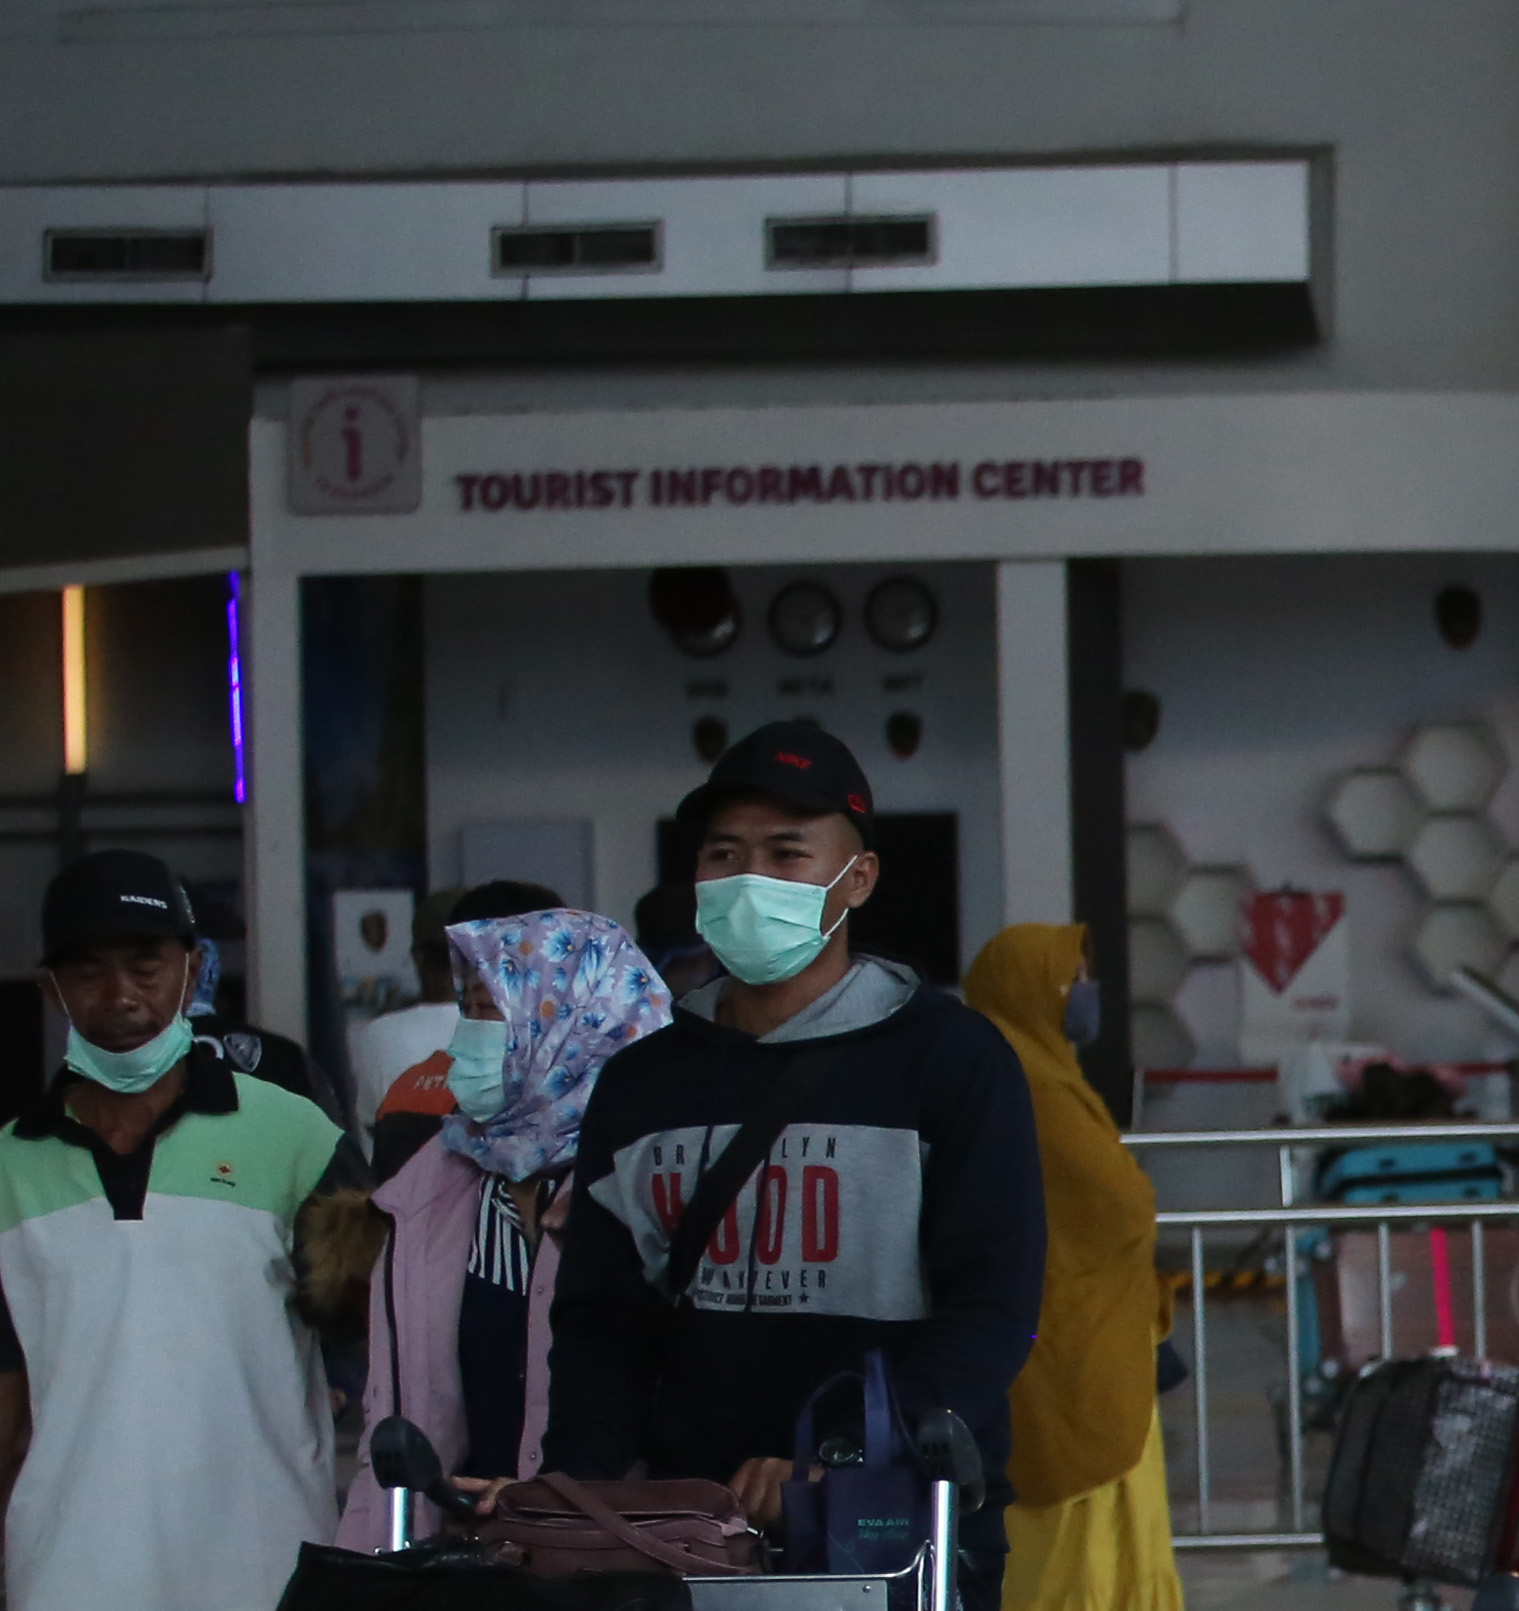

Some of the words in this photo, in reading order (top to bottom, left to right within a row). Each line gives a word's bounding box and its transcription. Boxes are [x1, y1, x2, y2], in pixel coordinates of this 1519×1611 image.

[454, 470, 639, 513] TOURIST
[647, 463, 960, 507] INFORMATION
[972, 458, 1145, 500] CENTER
[653, 1137, 837, 1167] BRLYN
